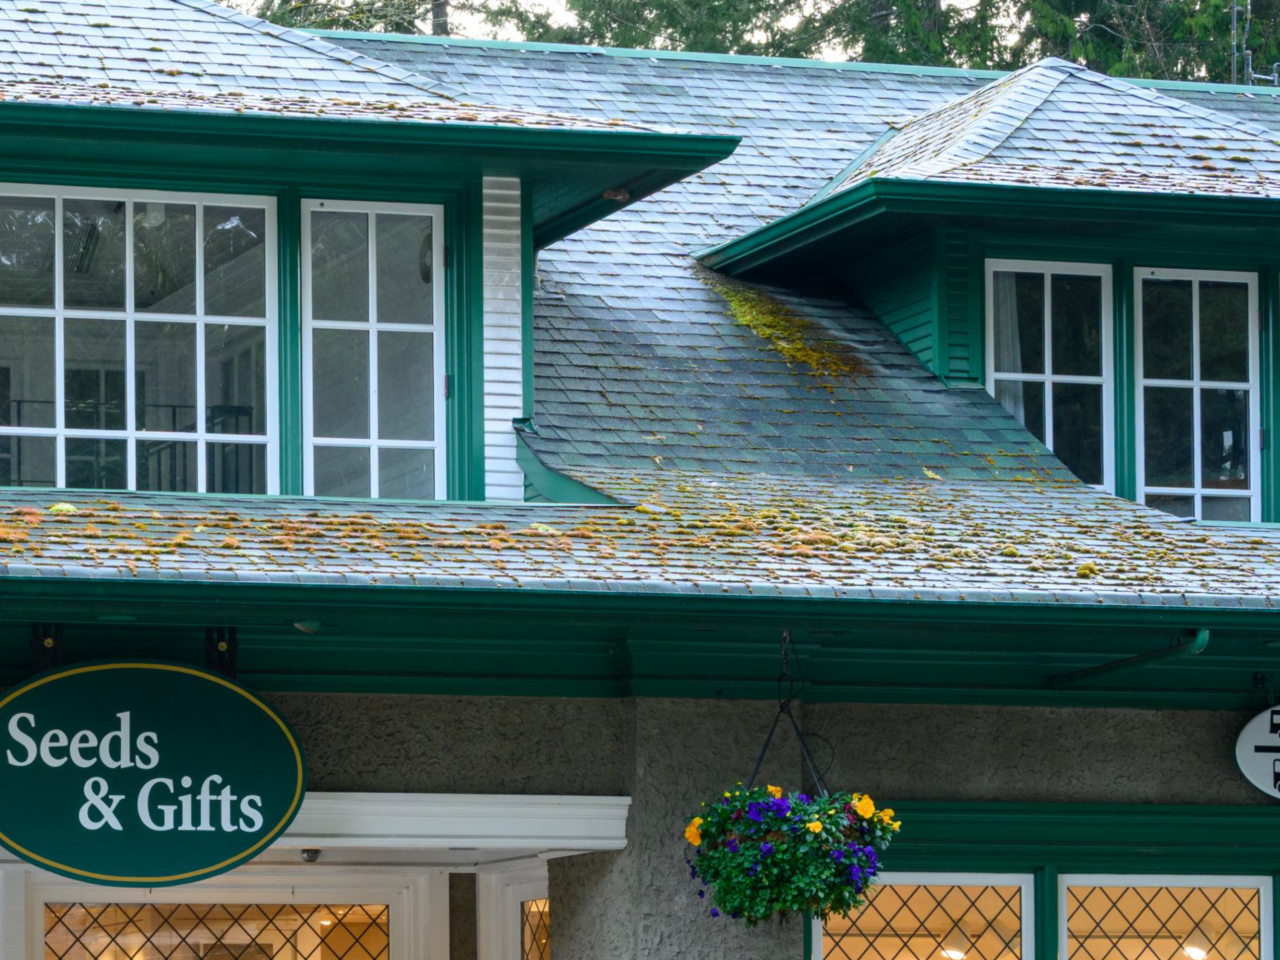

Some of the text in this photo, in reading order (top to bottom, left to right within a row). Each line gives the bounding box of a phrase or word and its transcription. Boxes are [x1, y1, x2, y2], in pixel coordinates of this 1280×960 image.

[6, 711, 160, 770] Seeds
[78, 774, 264, 833] & Gifts
